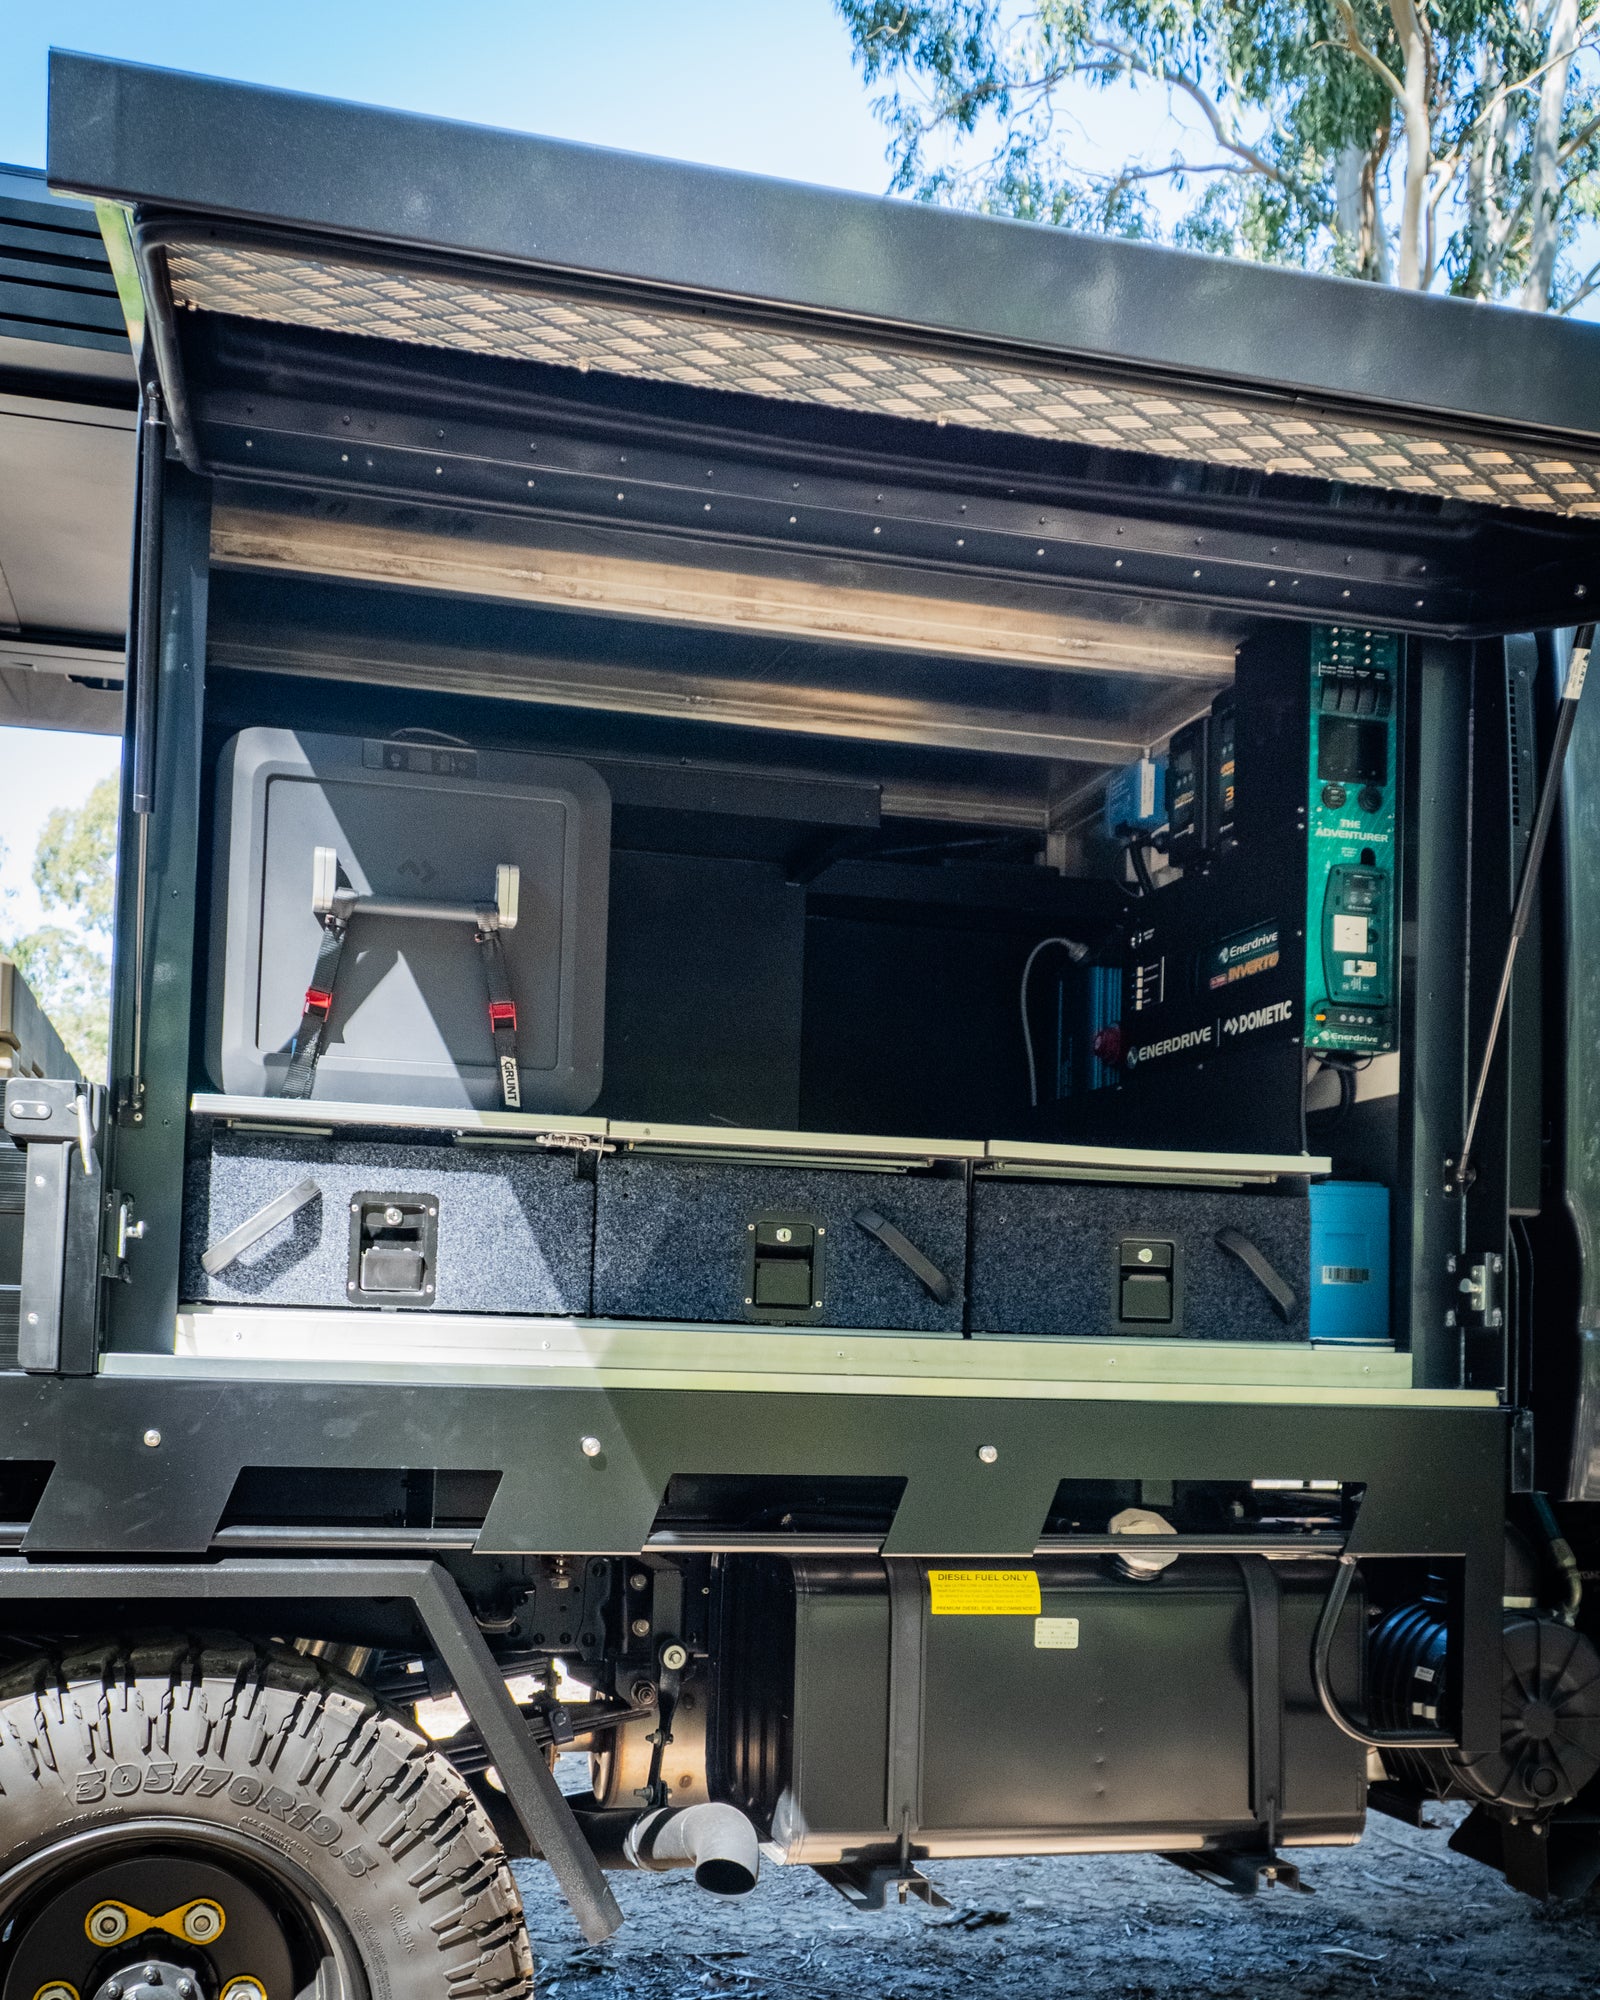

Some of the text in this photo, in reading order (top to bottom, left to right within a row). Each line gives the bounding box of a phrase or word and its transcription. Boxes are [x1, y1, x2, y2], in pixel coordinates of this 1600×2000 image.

[1340, 818, 1361, 828] THE
[1315, 827, 1388, 842] ADVENTURER
[1229, 931, 1278, 957] Enerdrive
[1138, 1000, 1293, 1061] ENERDRIVE DOMETIC
[1331, 1032, 1378, 1043] Enerdrive
[504, 1061, 517, 1101] GRUNT
[937, 1573, 1029, 1581] DIESEL FUEL ONLY
[76, 1762, 379, 1877] 305/70R19.5
